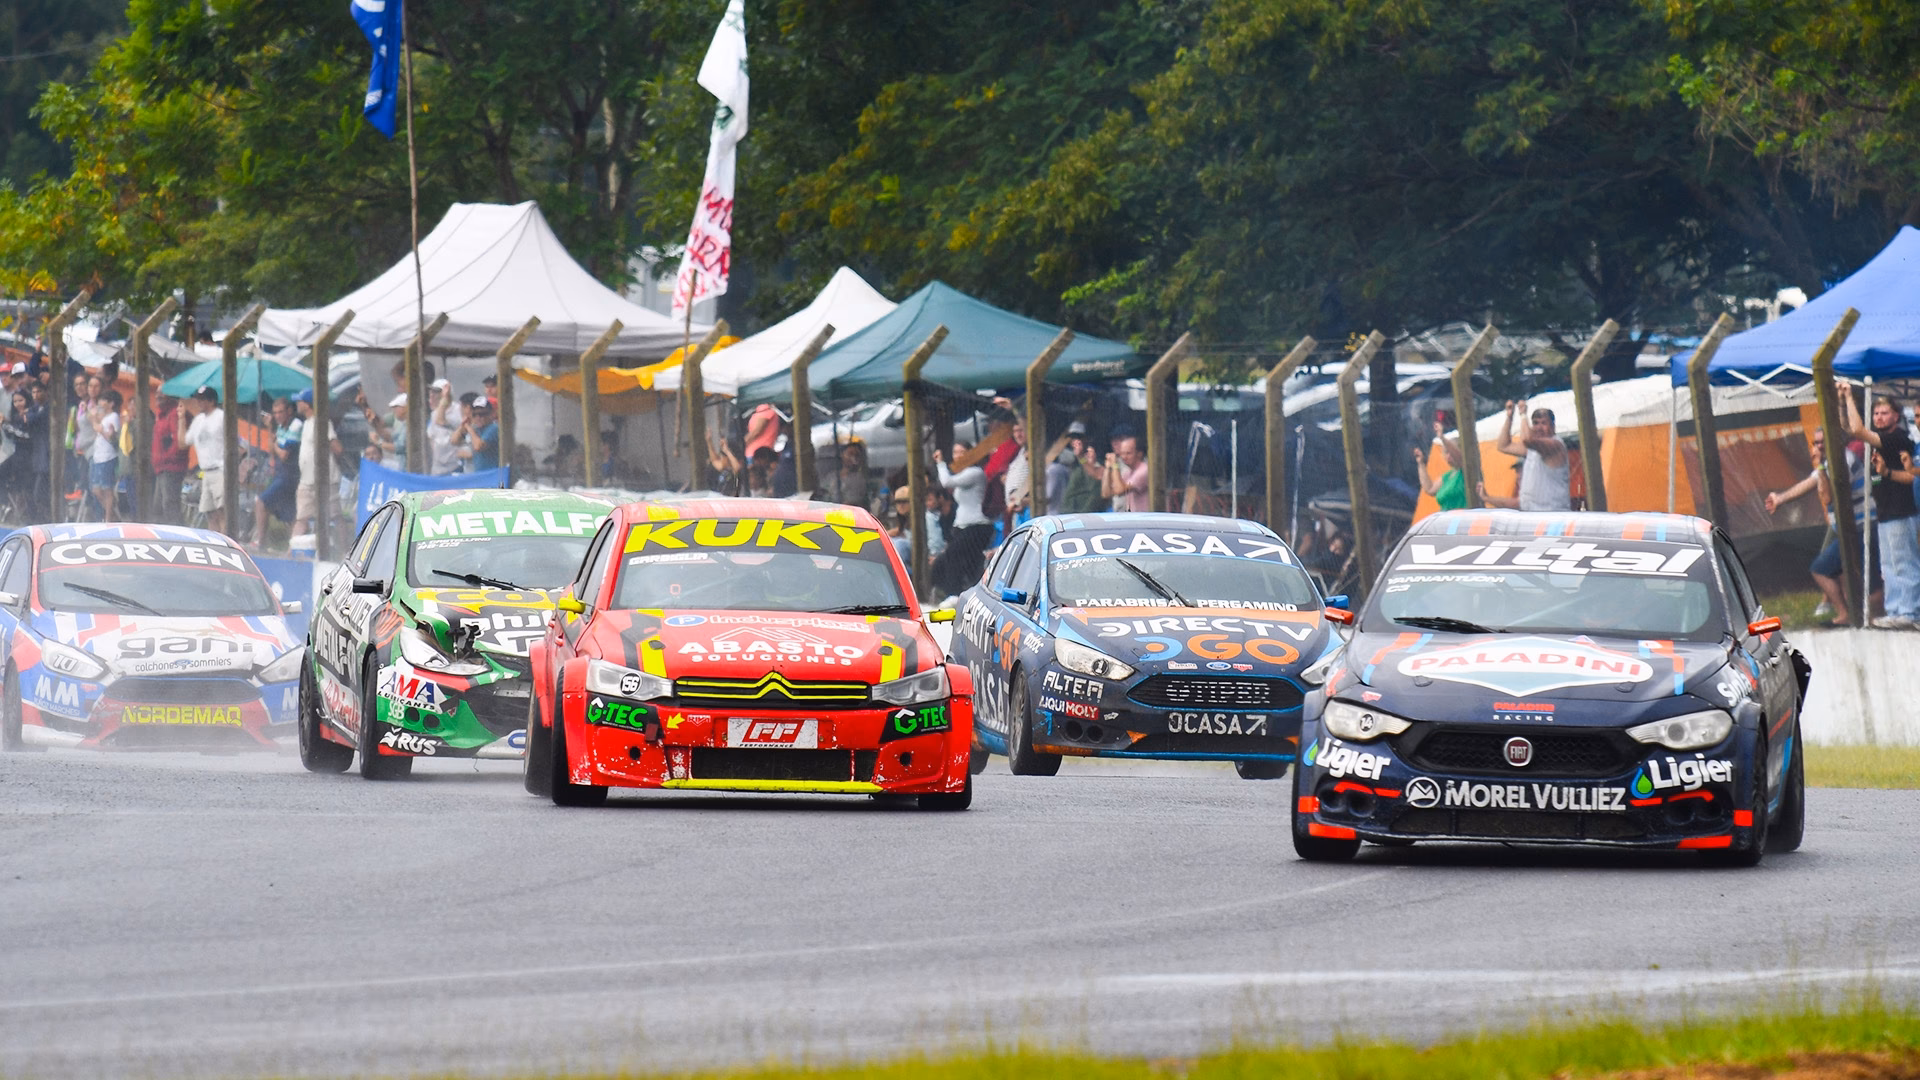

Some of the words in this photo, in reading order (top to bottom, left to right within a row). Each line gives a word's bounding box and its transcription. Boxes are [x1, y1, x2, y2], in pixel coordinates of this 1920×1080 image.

[624, 518, 881, 554] KUKY
[1051, 532, 1235, 558] OCASA
[50, 543, 246, 572] CORVEN
[1410, 537, 1705, 575] vittal
[1197, 599, 1298, 612] PERGAMINO
[1092, 616, 1313, 642] DIRECTV
[117, 636, 254, 659] gani
[678, 640, 865, 659] ABASTO
[691, 653, 852, 666] SOLUCIONES
[53, 653, 79, 672] 10
[190, 657, 232, 669] sommiers
[1410, 651, 1642, 677] PALADINI
[381, 670, 437, 705] AMA
[621, 675, 641, 693] 156
[121, 705, 243, 728] NORDEMAQ
[1038, 695, 1066, 713] LIQUI
[1066, 701, 1099, 719] MOLY
[1493, 714, 1554, 722] RACING
[748, 722, 798, 740] FF
[1167, 712, 1243, 736] OCASA
[1315, 736, 1392, 781] Ligier
[1509, 745, 1528, 759] FIAT
[1647, 753, 1734, 792] Ligier
[1444, 780, 1531, 809] MOREL
[1531, 783, 1627, 811] VULLIEZ
